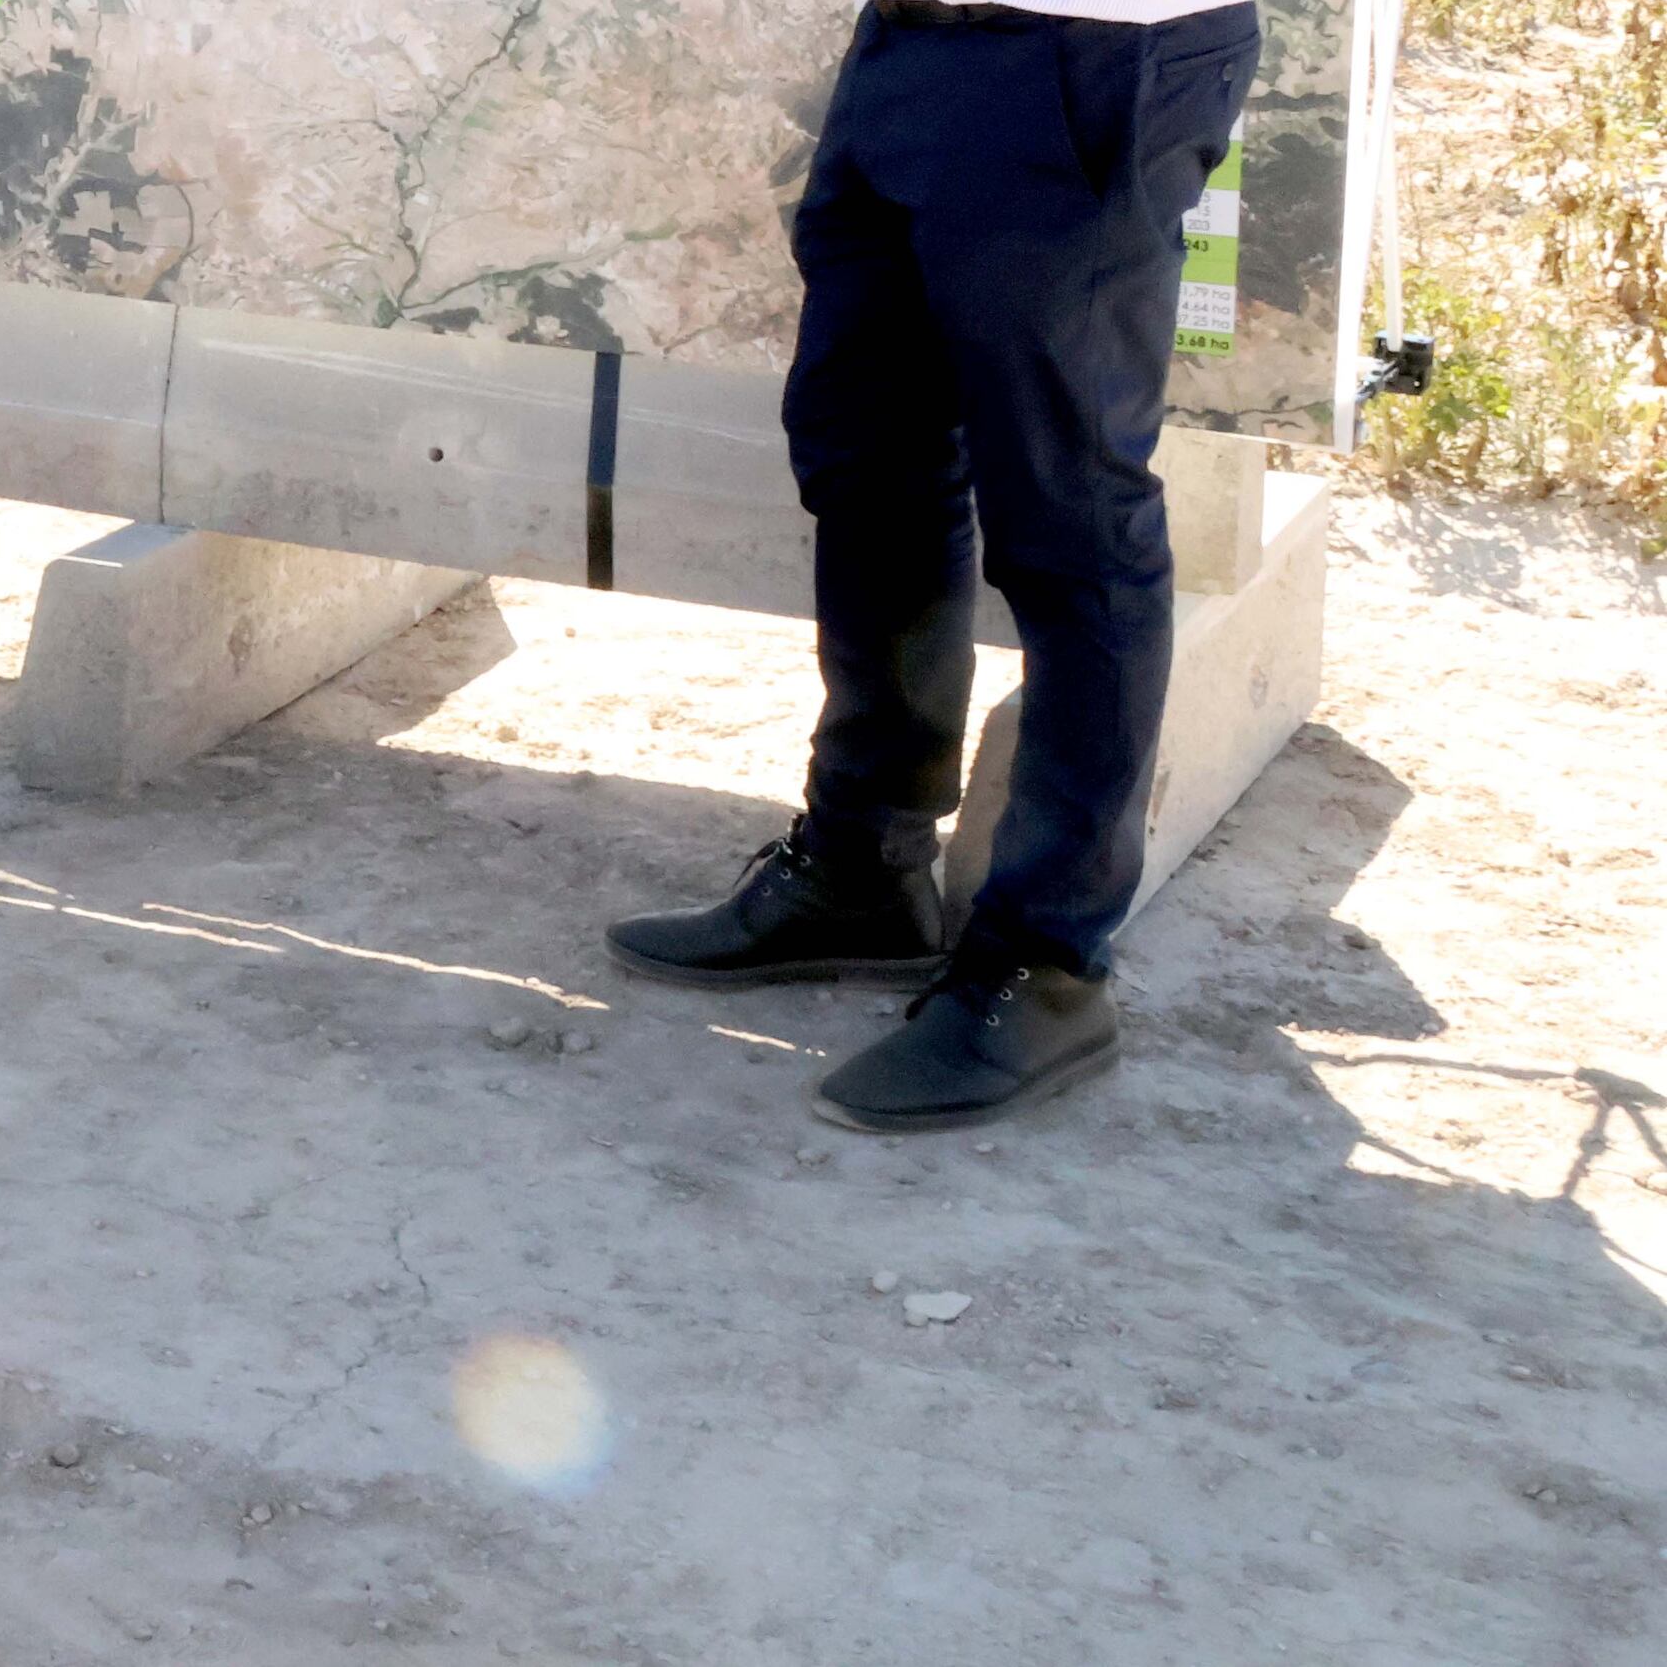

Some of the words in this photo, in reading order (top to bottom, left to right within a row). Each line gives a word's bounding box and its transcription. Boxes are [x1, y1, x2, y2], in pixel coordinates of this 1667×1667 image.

[1212, 303, 1230, 315] ha
[1212, 316, 1230, 329] ha
[1211, 338, 1229, 351] ha
